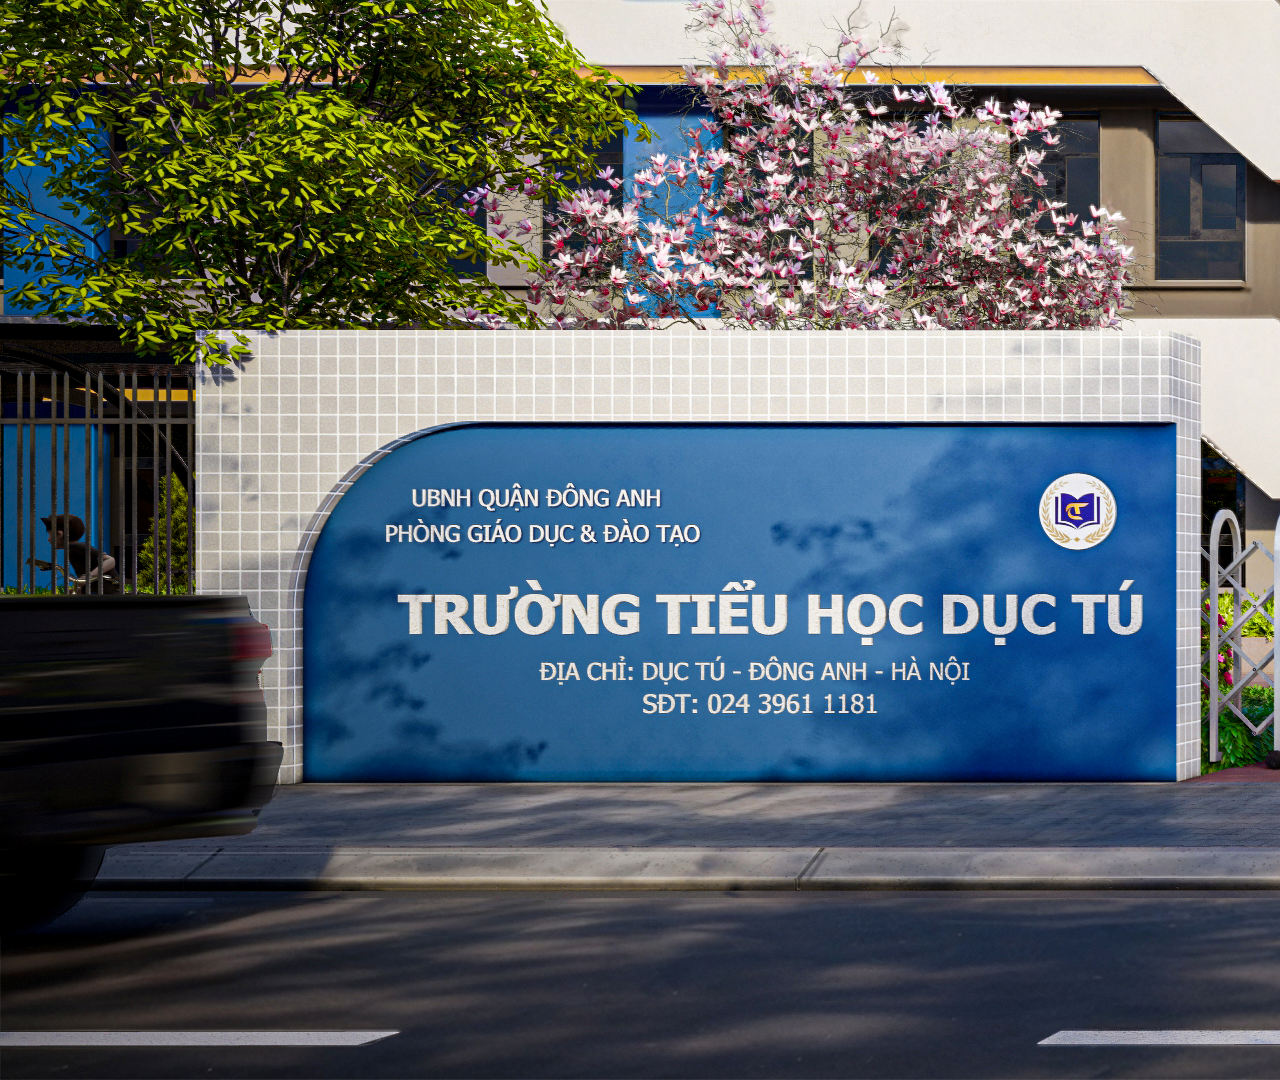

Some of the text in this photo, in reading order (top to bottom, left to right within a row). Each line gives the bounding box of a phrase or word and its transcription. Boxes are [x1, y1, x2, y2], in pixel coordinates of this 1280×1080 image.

[412, 482, 661, 512] UBNH QUẬN ĐÔNG ANH
[385, 518, 701, 547] PHÒNG GIÁO DỤC & ĐÀO TẠO
[397, 579, 1143, 646] TRƯỜNG TIỂU HỌC DỤC TÚ
[539, 662, 581, 685] ĐỊA
[586, 655, 633, 681] CHỈ:
[642, 661, 689, 685] DỤC
[694, 655, 725, 682] TÚ
[747, 655, 814, 681] ĐÔNG
[820, 662, 867, 681] ANH
[891, 655, 922, 681] HÀ
[929, 655, 970, 685] NỘI
[642, 693, 877, 715] SĐT: 024 3961 1181
